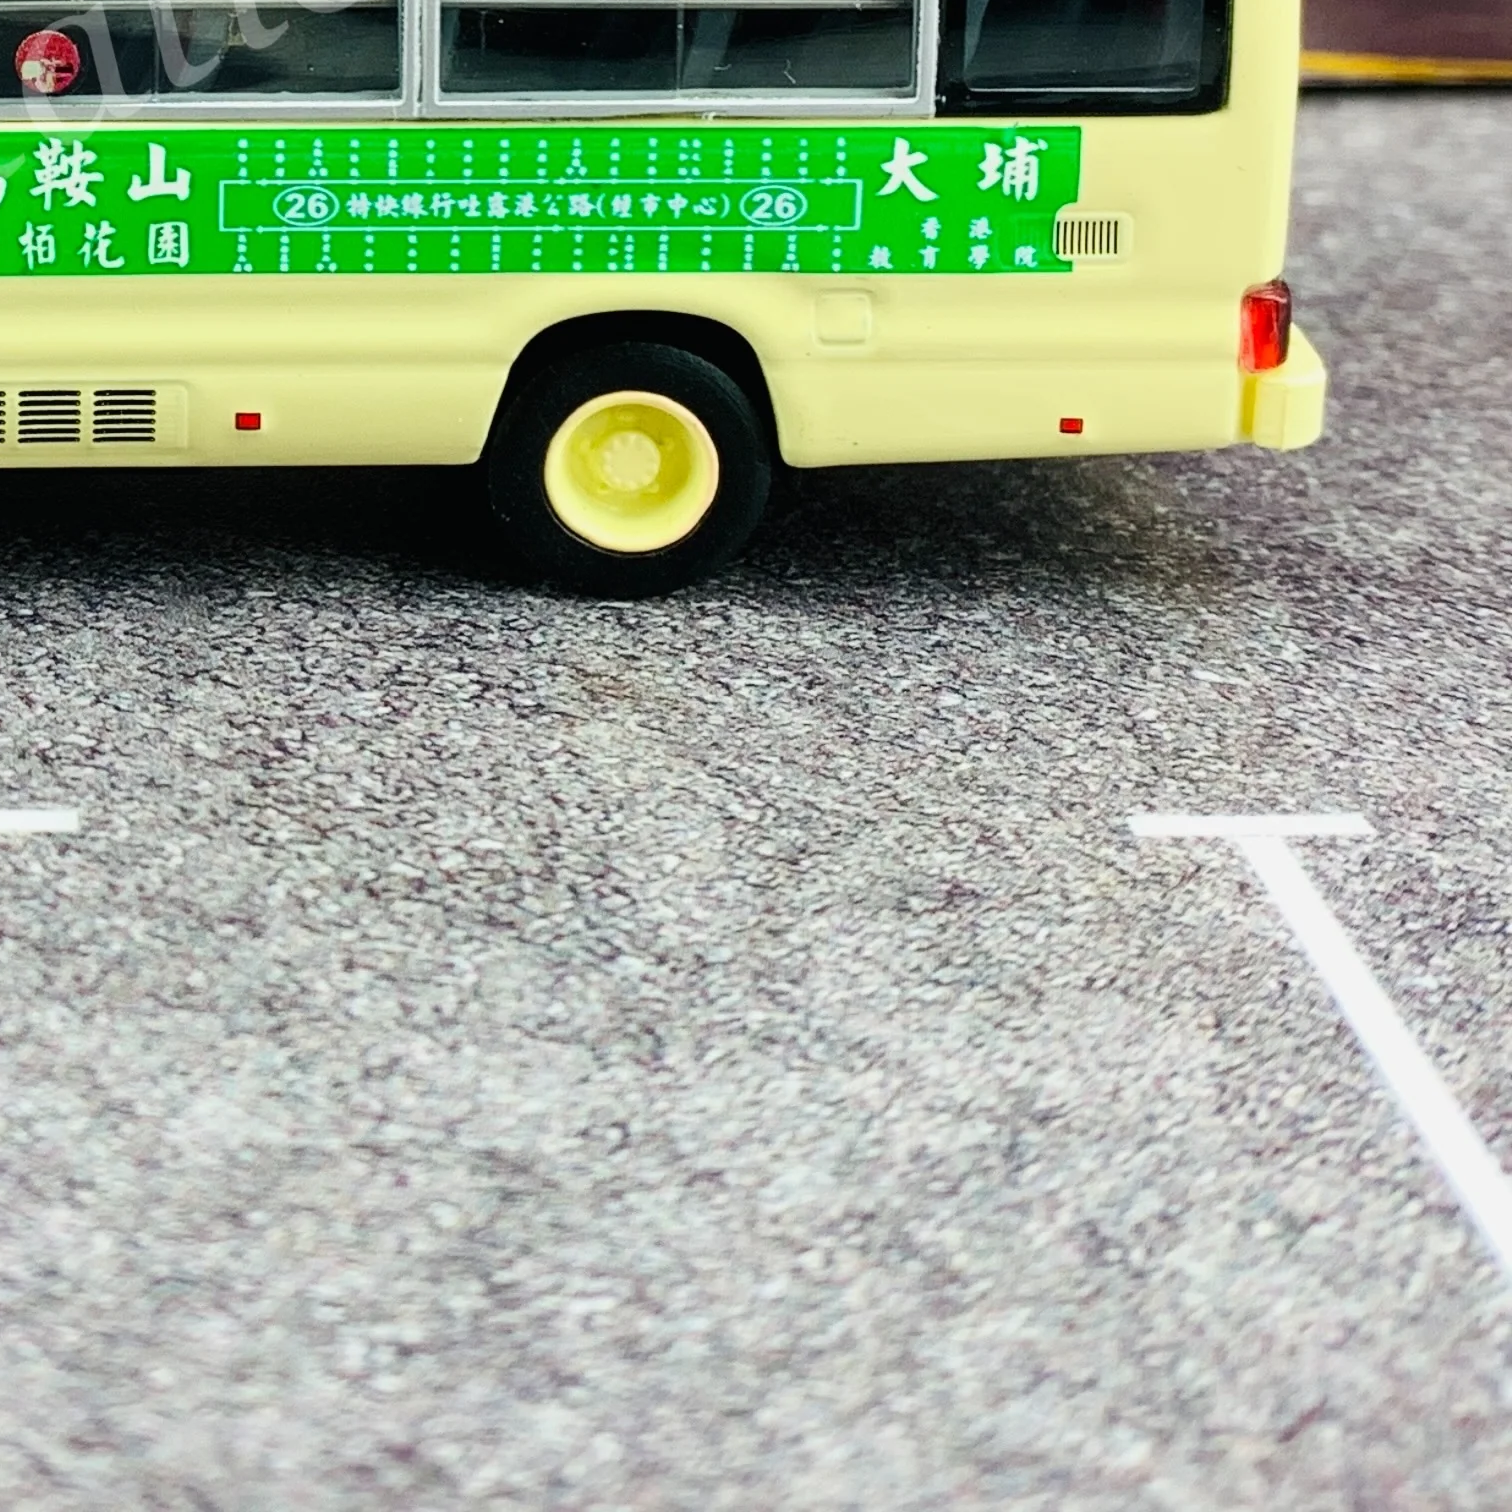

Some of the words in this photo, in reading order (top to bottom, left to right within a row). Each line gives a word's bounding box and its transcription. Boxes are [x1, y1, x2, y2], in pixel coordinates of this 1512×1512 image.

[875, 135, 1049, 203] 大埔
[284, 192, 329, 220] 26
[751, 192, 797, 220] 26
